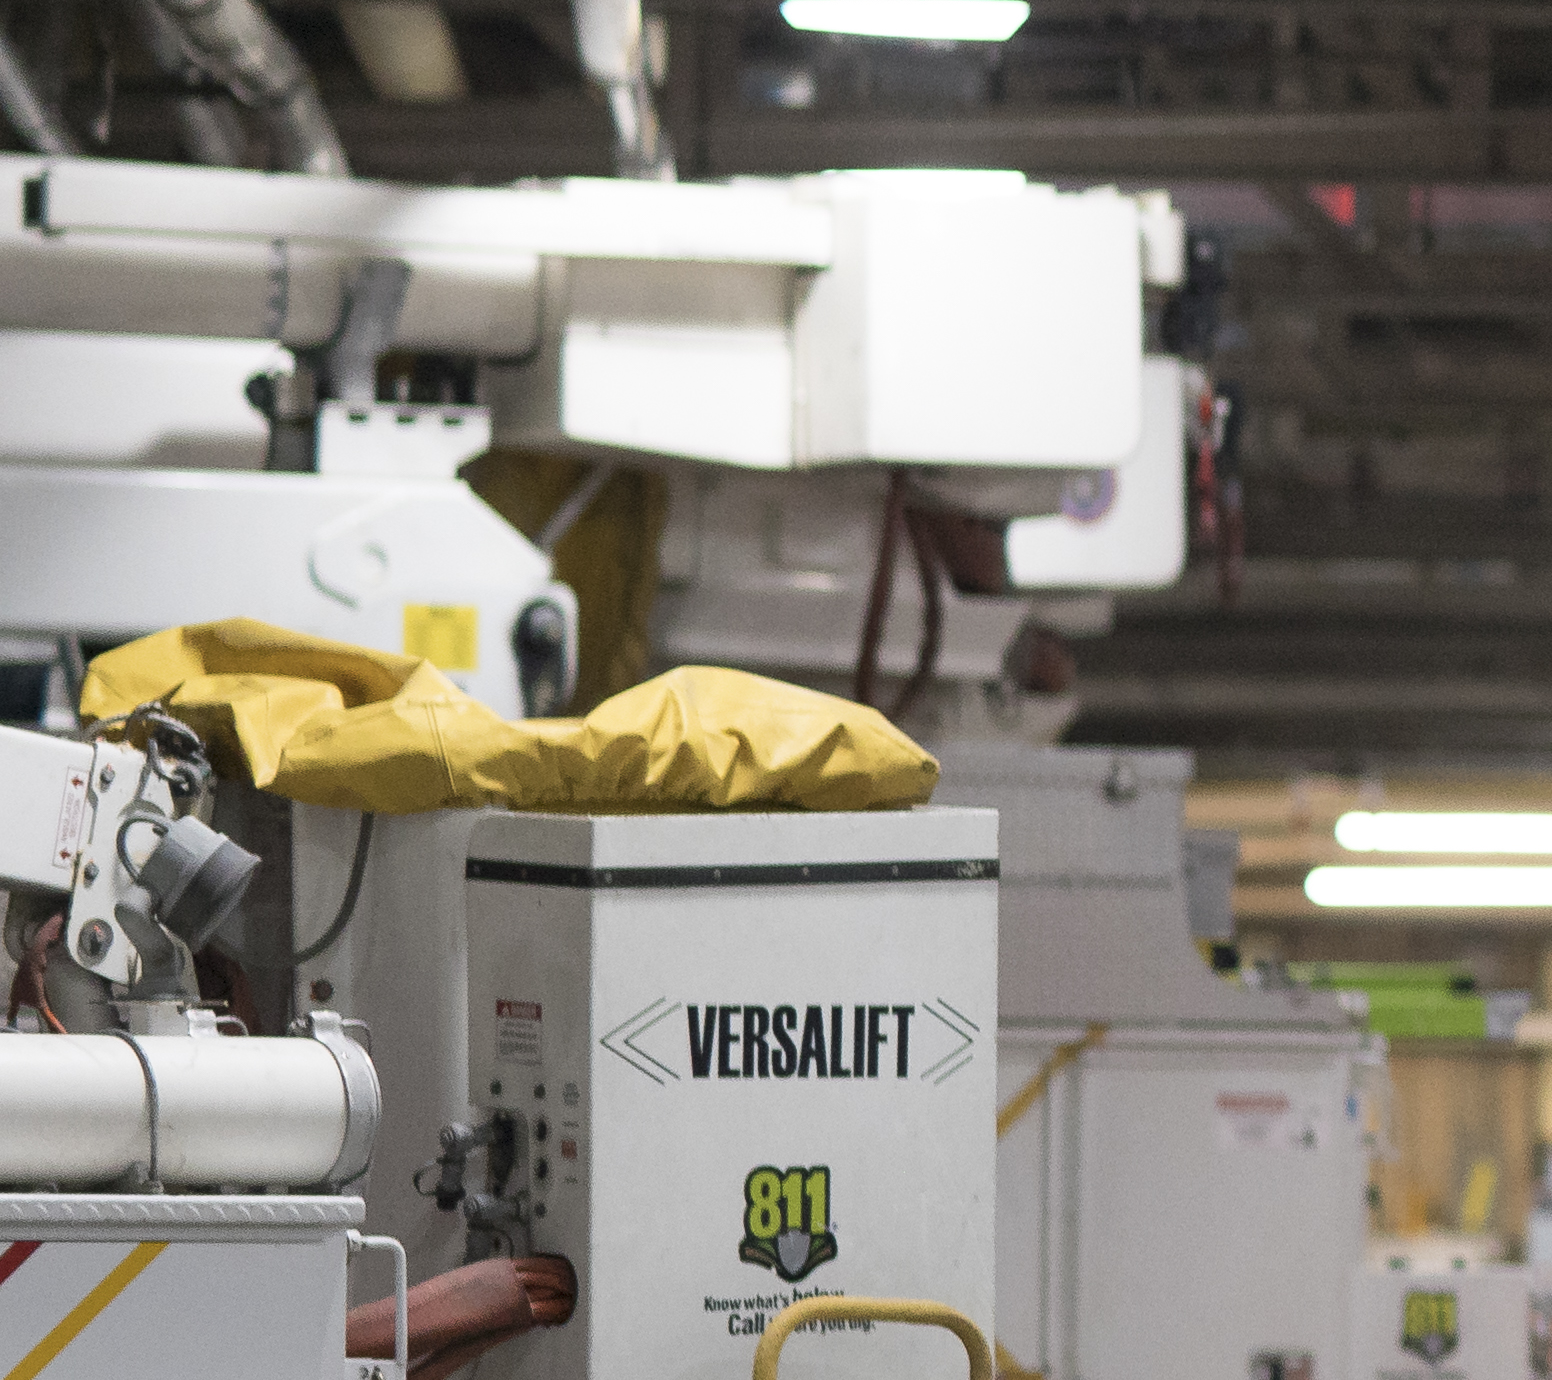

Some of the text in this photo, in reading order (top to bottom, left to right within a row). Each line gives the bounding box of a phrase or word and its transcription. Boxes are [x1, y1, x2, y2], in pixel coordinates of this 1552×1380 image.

[686, 1004, 916, 1079] VERSALIFT
[745, 1167, 829, 1239] 811
[704, 1296, 741, 1312] Know
[728, 1313, 766, 1336] Call
